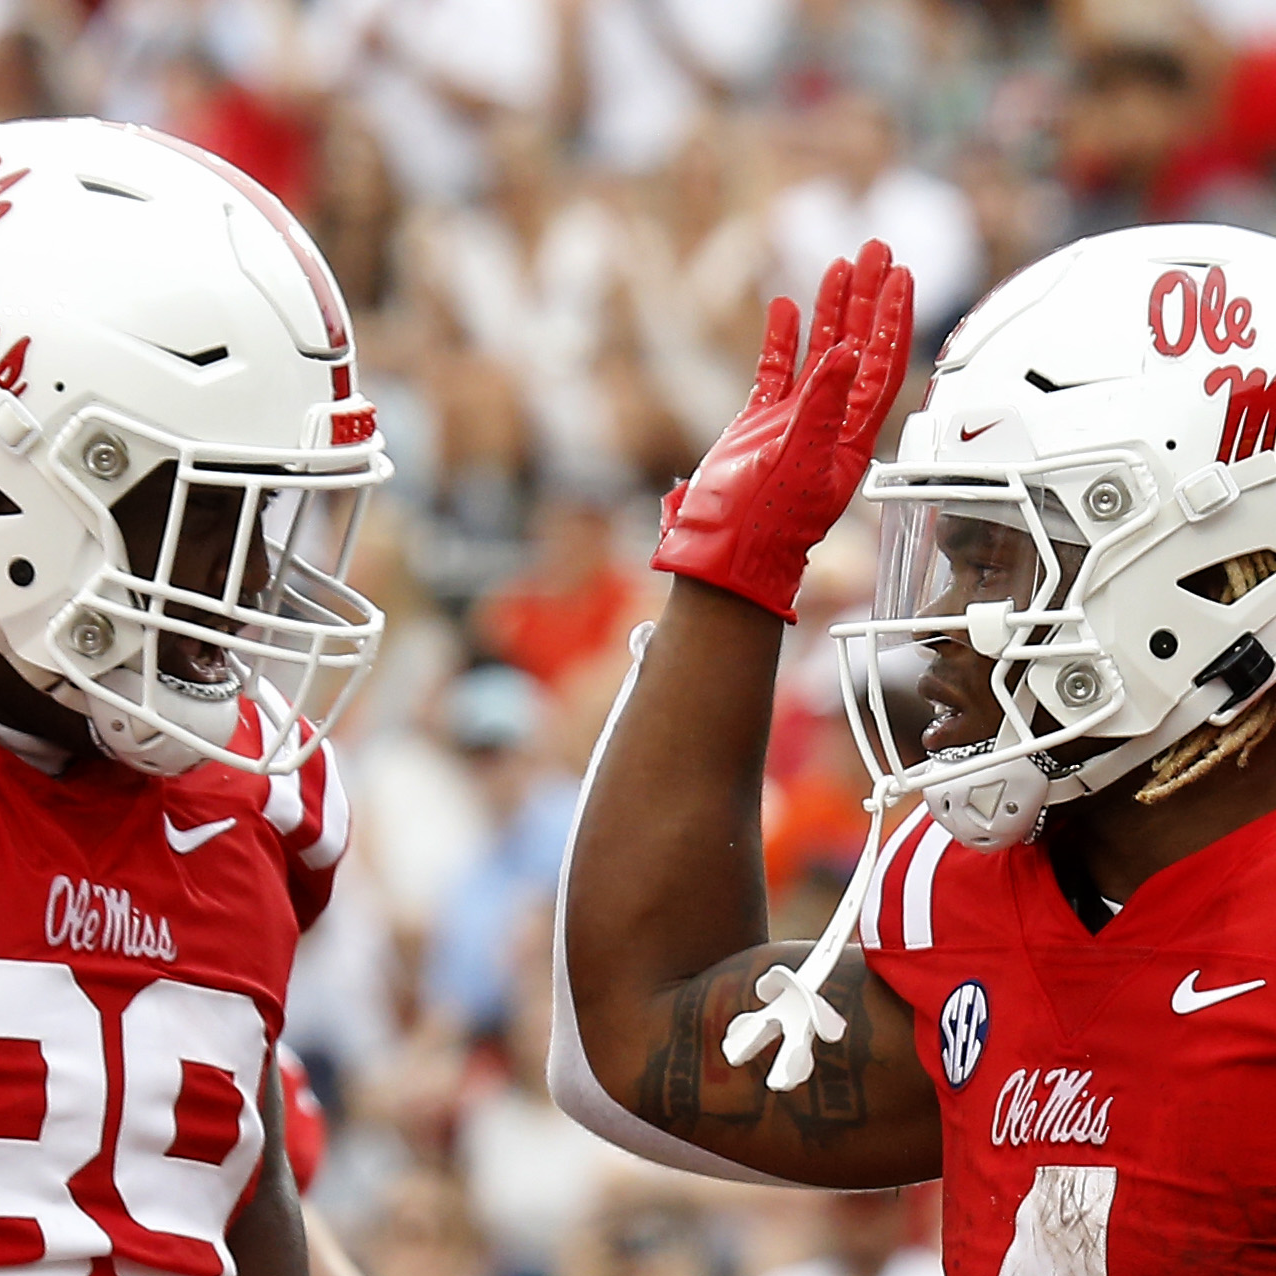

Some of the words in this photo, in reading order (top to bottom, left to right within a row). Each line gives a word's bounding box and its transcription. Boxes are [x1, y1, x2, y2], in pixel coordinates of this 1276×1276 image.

[1148, 265, 1257, 357] Ole
[45, 874, 100, 951] Ole
[93, 883, 177, 961] Miss
[940, 983, 988, 1084] SEC
[991, 1067, 1041, 1146] Ole
[1033, 1067, 1114, 1145] Miss
